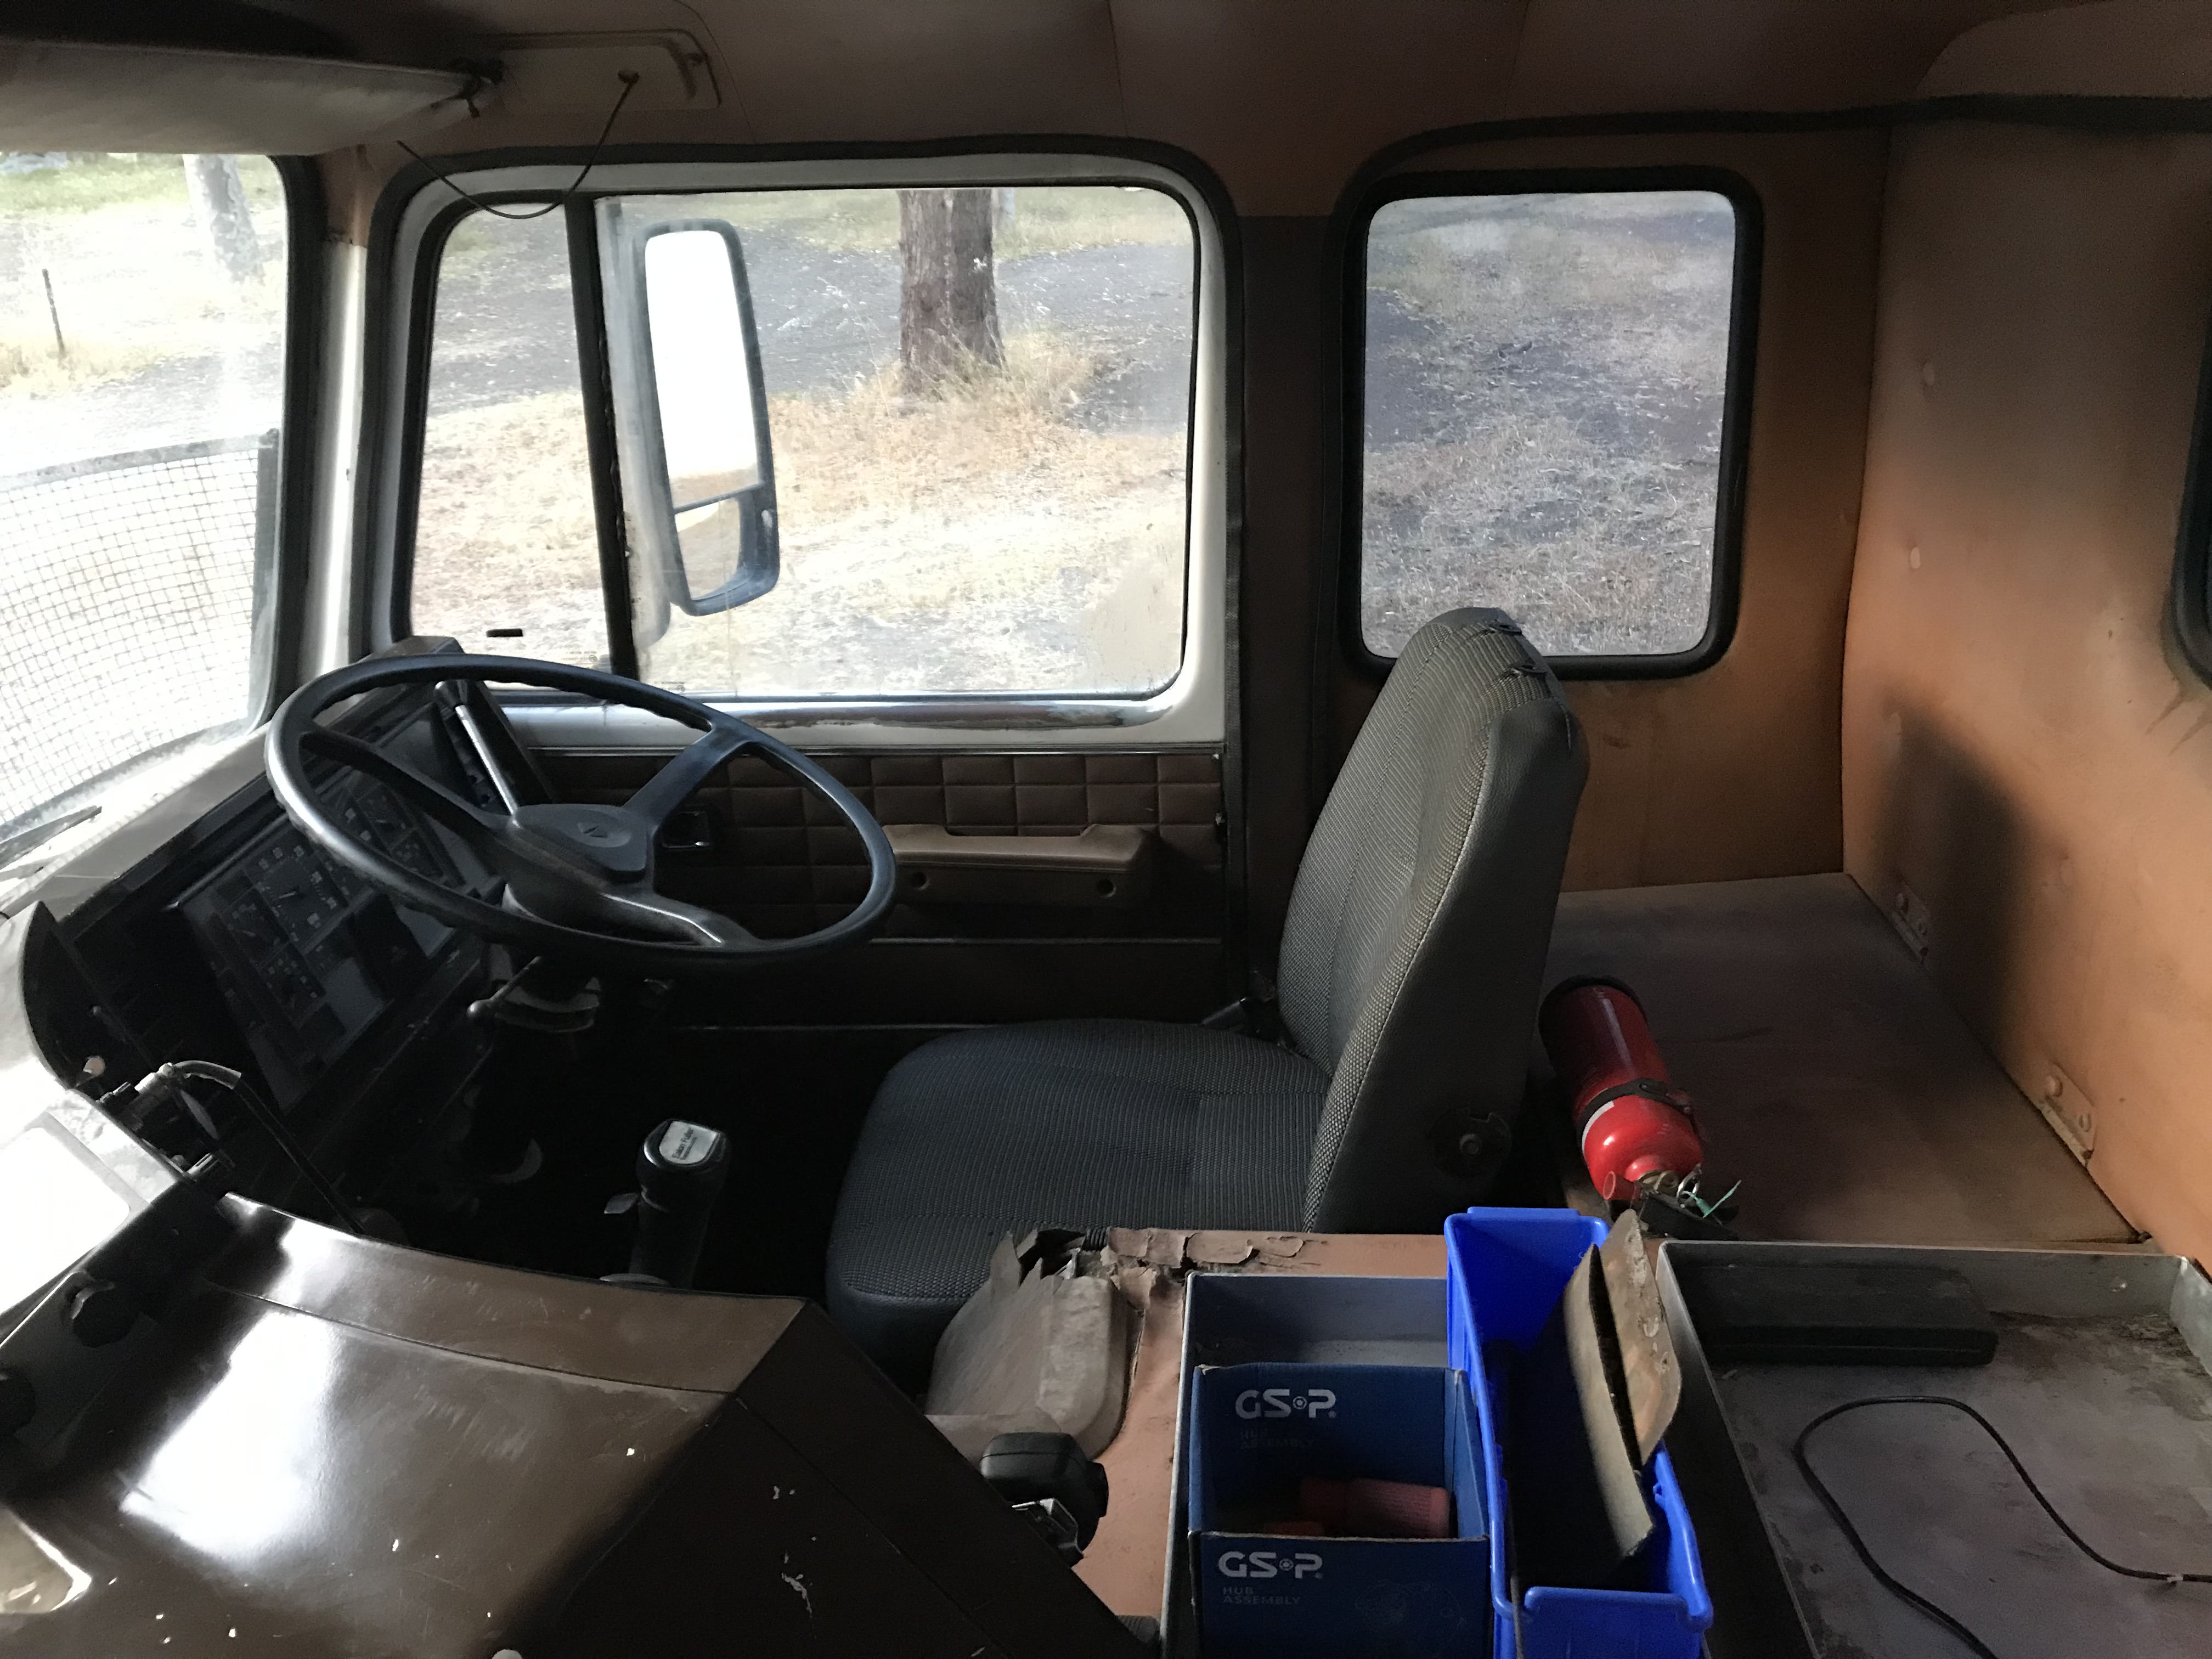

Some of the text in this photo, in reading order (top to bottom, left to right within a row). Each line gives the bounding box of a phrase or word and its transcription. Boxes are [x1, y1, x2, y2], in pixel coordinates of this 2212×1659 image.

[1235, 1388, 1336, 1419] GSP
[1217, 1550, 1323, 1579] GSP
[1223, 1587, 1254, 1595] HUB
[1223, 1595, 1300, 1605] ASSEMBLY
